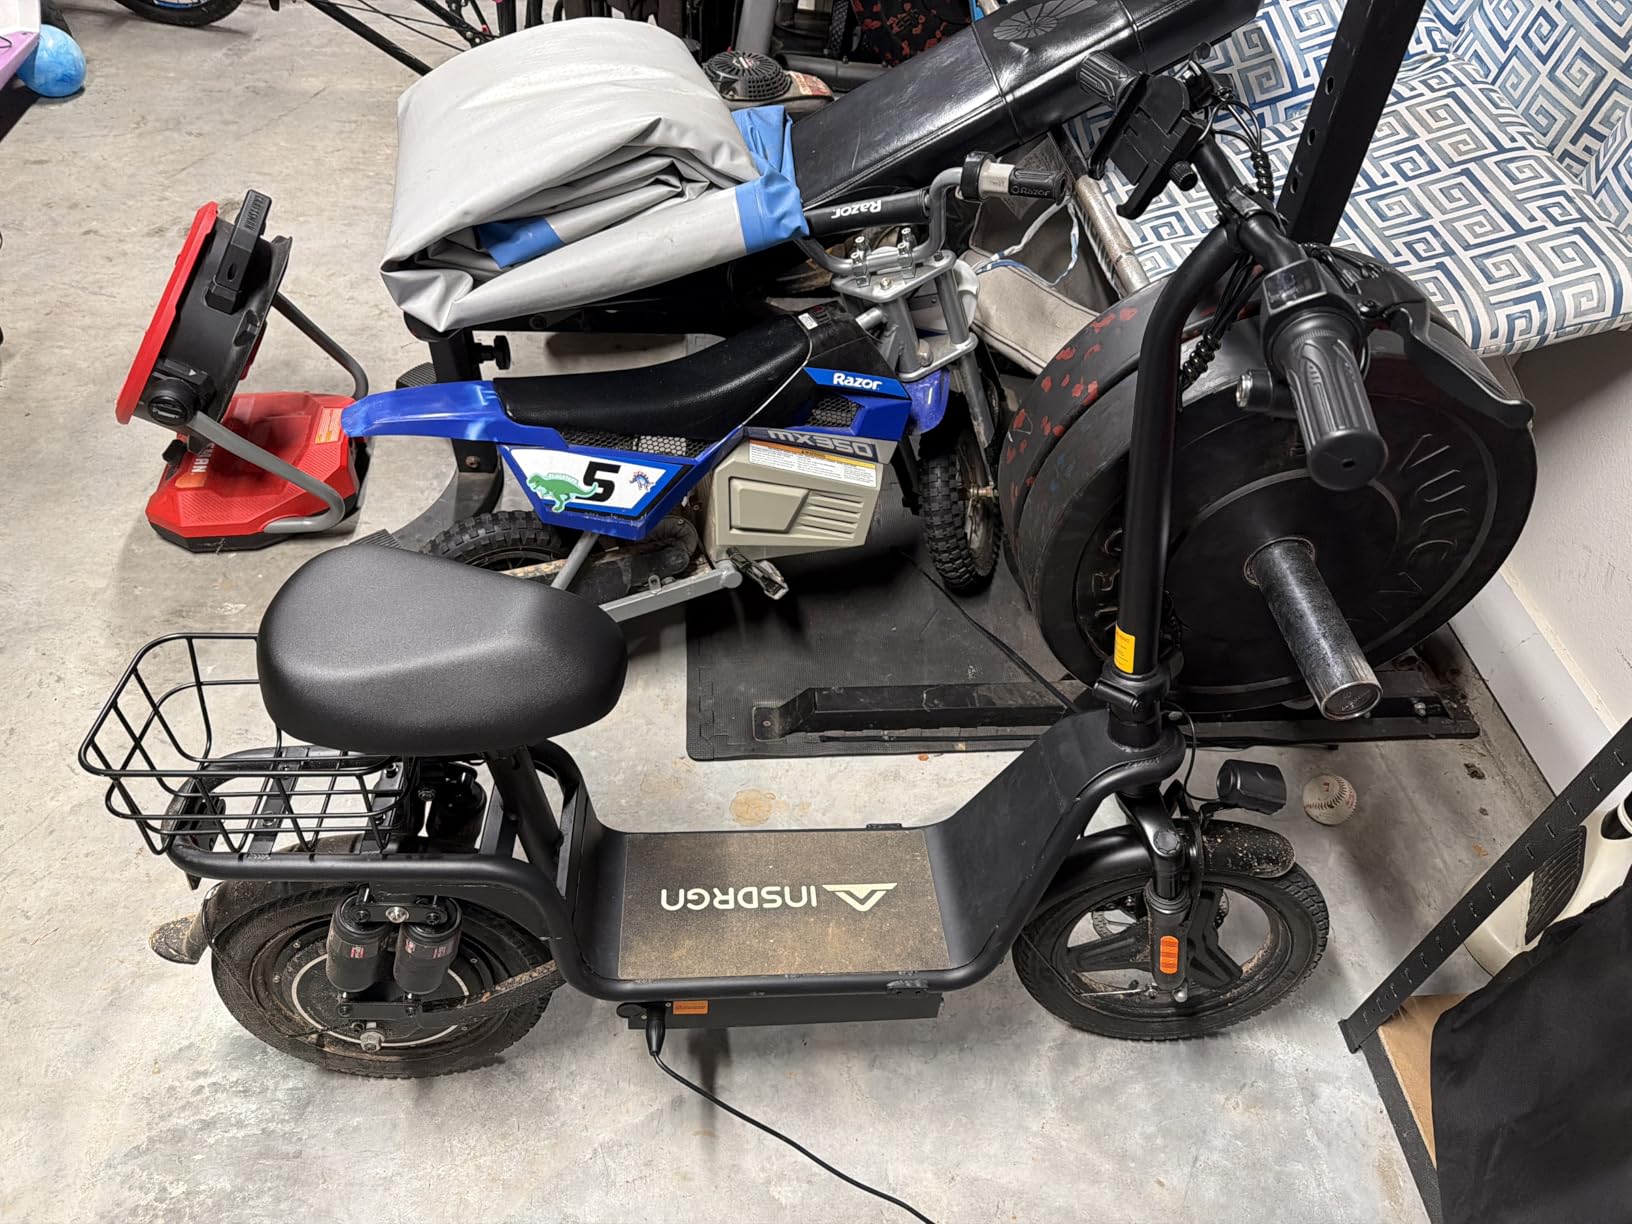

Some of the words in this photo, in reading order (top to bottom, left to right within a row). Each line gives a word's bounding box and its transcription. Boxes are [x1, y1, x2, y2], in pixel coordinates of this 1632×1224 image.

[1019, 186, 1051, 197] Razor
[831, 199, 882, 219] Razor
[832, 372, 883, 390] Razor
[574, 460, 621, 502] 5
